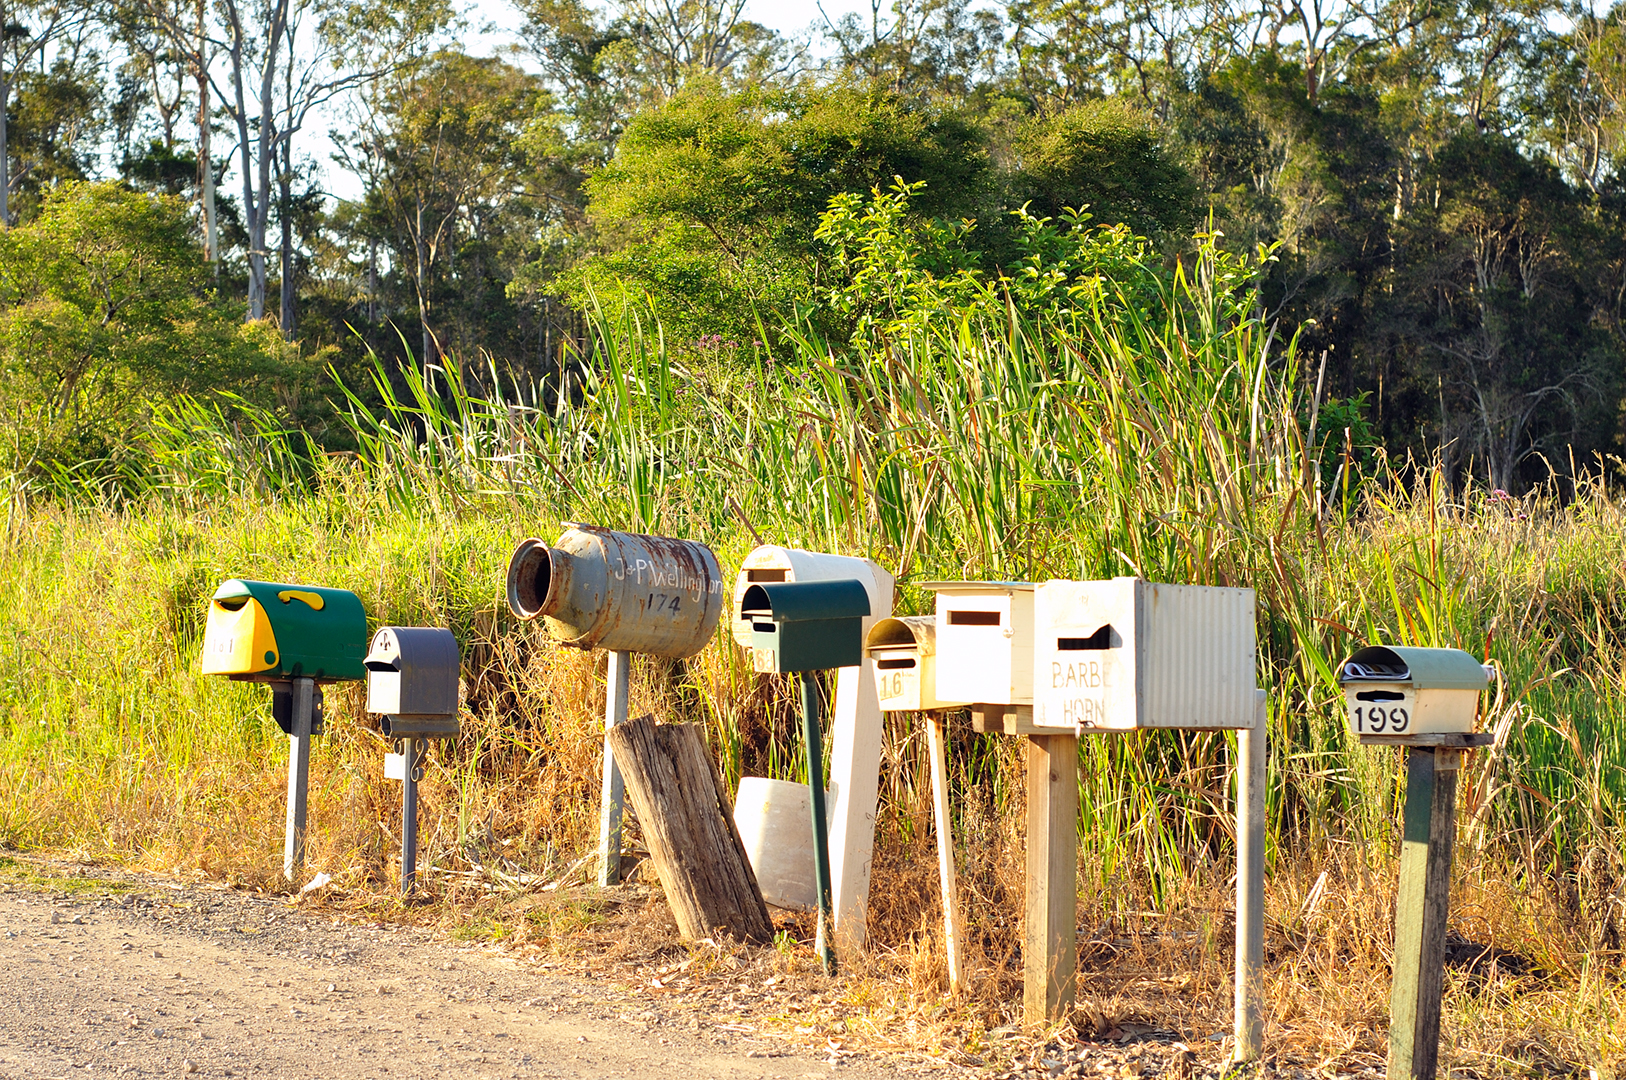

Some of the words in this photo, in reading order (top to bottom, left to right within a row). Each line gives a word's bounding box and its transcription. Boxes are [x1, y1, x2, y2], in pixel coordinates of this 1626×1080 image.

[648, 560, 723, 603] Wellington
[648, 593, 681, 616] 174
[1064, 697, 1105, 724] HORN
[1354, 706, 1409, 733] 199
